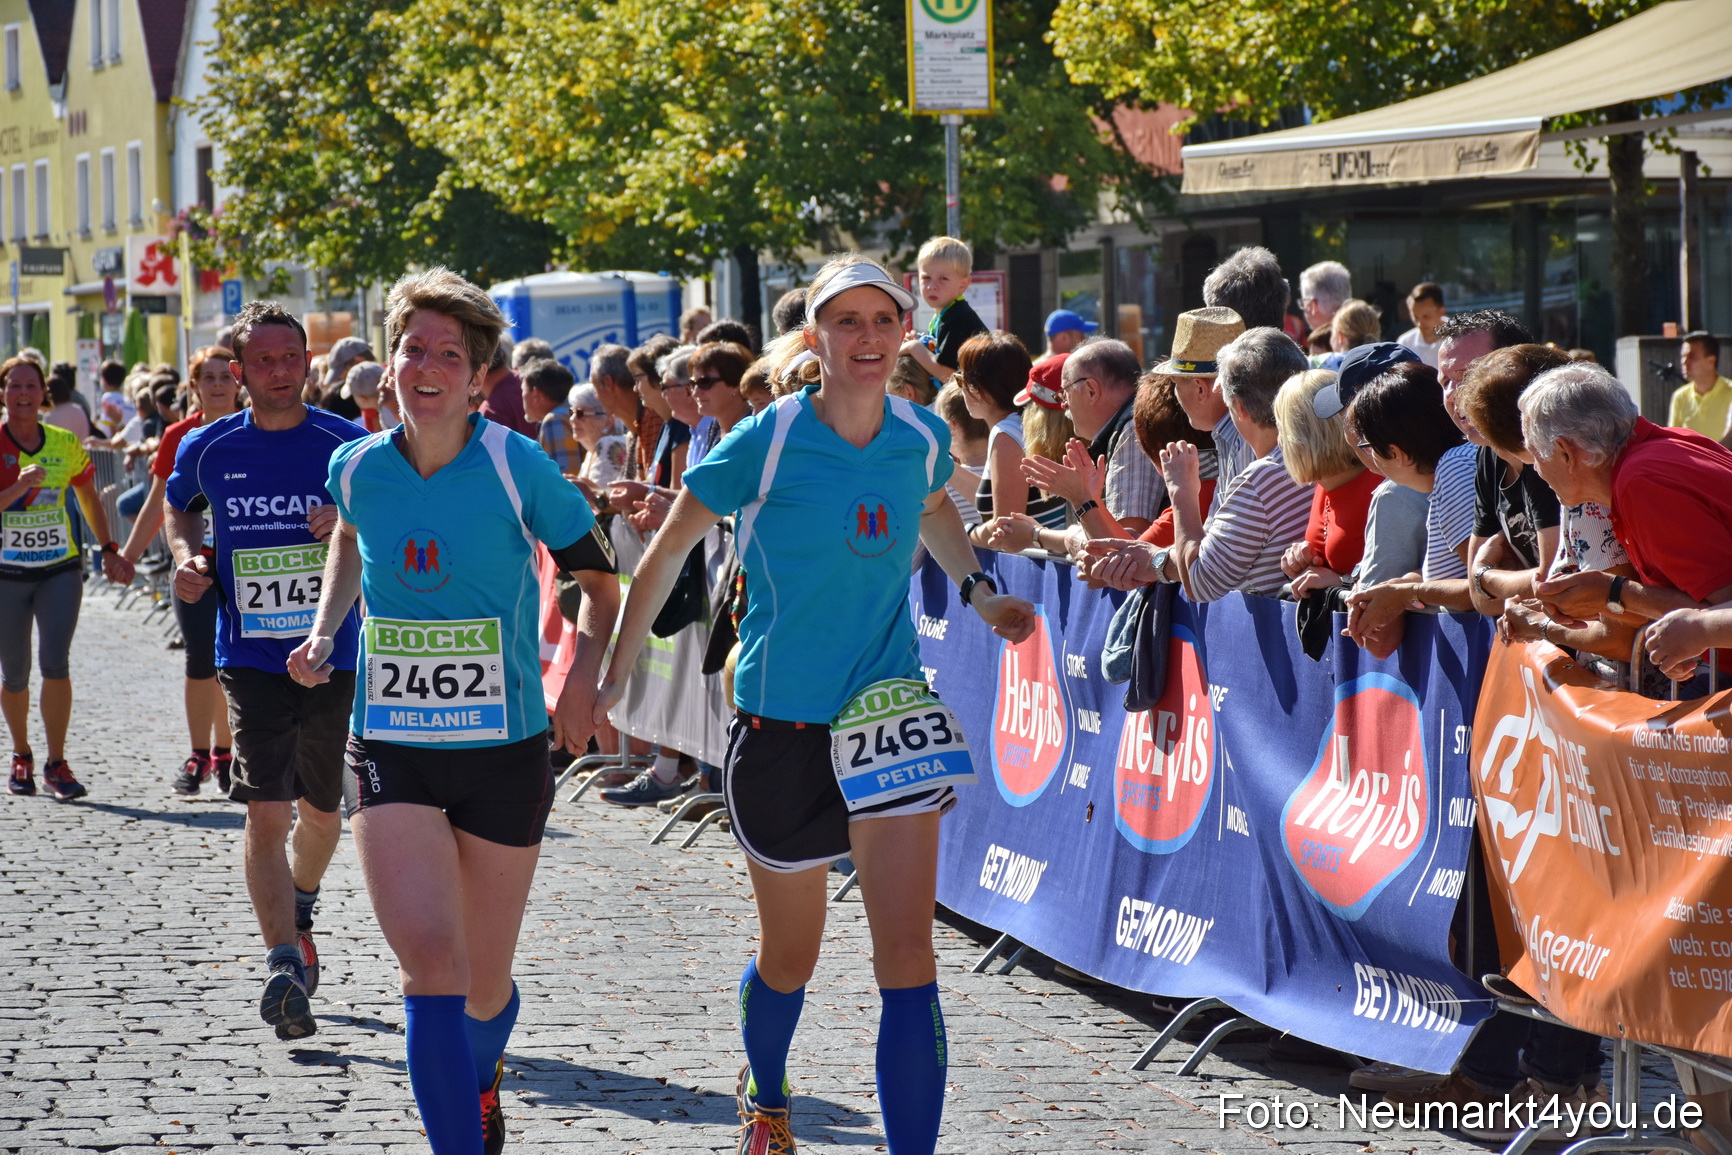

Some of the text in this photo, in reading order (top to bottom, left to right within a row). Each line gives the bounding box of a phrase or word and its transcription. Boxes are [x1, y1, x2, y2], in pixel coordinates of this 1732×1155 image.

[925, 31, 975, 40] Marktplatz
[8, 511, 60, 527] BOCK
[226, 495, 323, 518] SYSCAD
[11, 529, 60, 548] 2695
[13, 549, 60, 561] ANDREA
[240, 549, 324, 572] BOCK
[247, 576, 322, 609] 2143
[377, 625, 487, 651] BOCK
[918, 614, 948, 640] STORE
[1066, 653, 1088, 679] STORE
[381, 662, 487, 700] 2462
[389, 710, 482, 728] MELANIE
[1000, 649, 1063, 762] Hervis
[1077, 708, 1101, 735] ONLINE
[847, 711, 953, 769] 2463
[1632, 725, 1692, 752] Neumarkts
[1002, 743, 1032, 770] SPORTS
[876, 758, 948, 788] PETRA
[1628, 757, 1732, 793] für die Konzeption
[1120, 780, 1161, 811] SPORTS
[1294, 732, 1420, 864] Hervis
[1655, 792, 1682, 816] Ihrer
[1649, 824, 1711, 861] Grafikdesign
[979, 843, 1011, 892] GET
[1300, 840, 1346, 873] SPORTS
[1115, 896, 1153, 949] GET
[1697, 901, 1724, 924] Sie
[1669, 932, 1708, 957] web:
[1669, 965, 1698, 989] tel:
[1353, 961, 1391, 1021] GET
[936, 1039, 946, 1067] under
